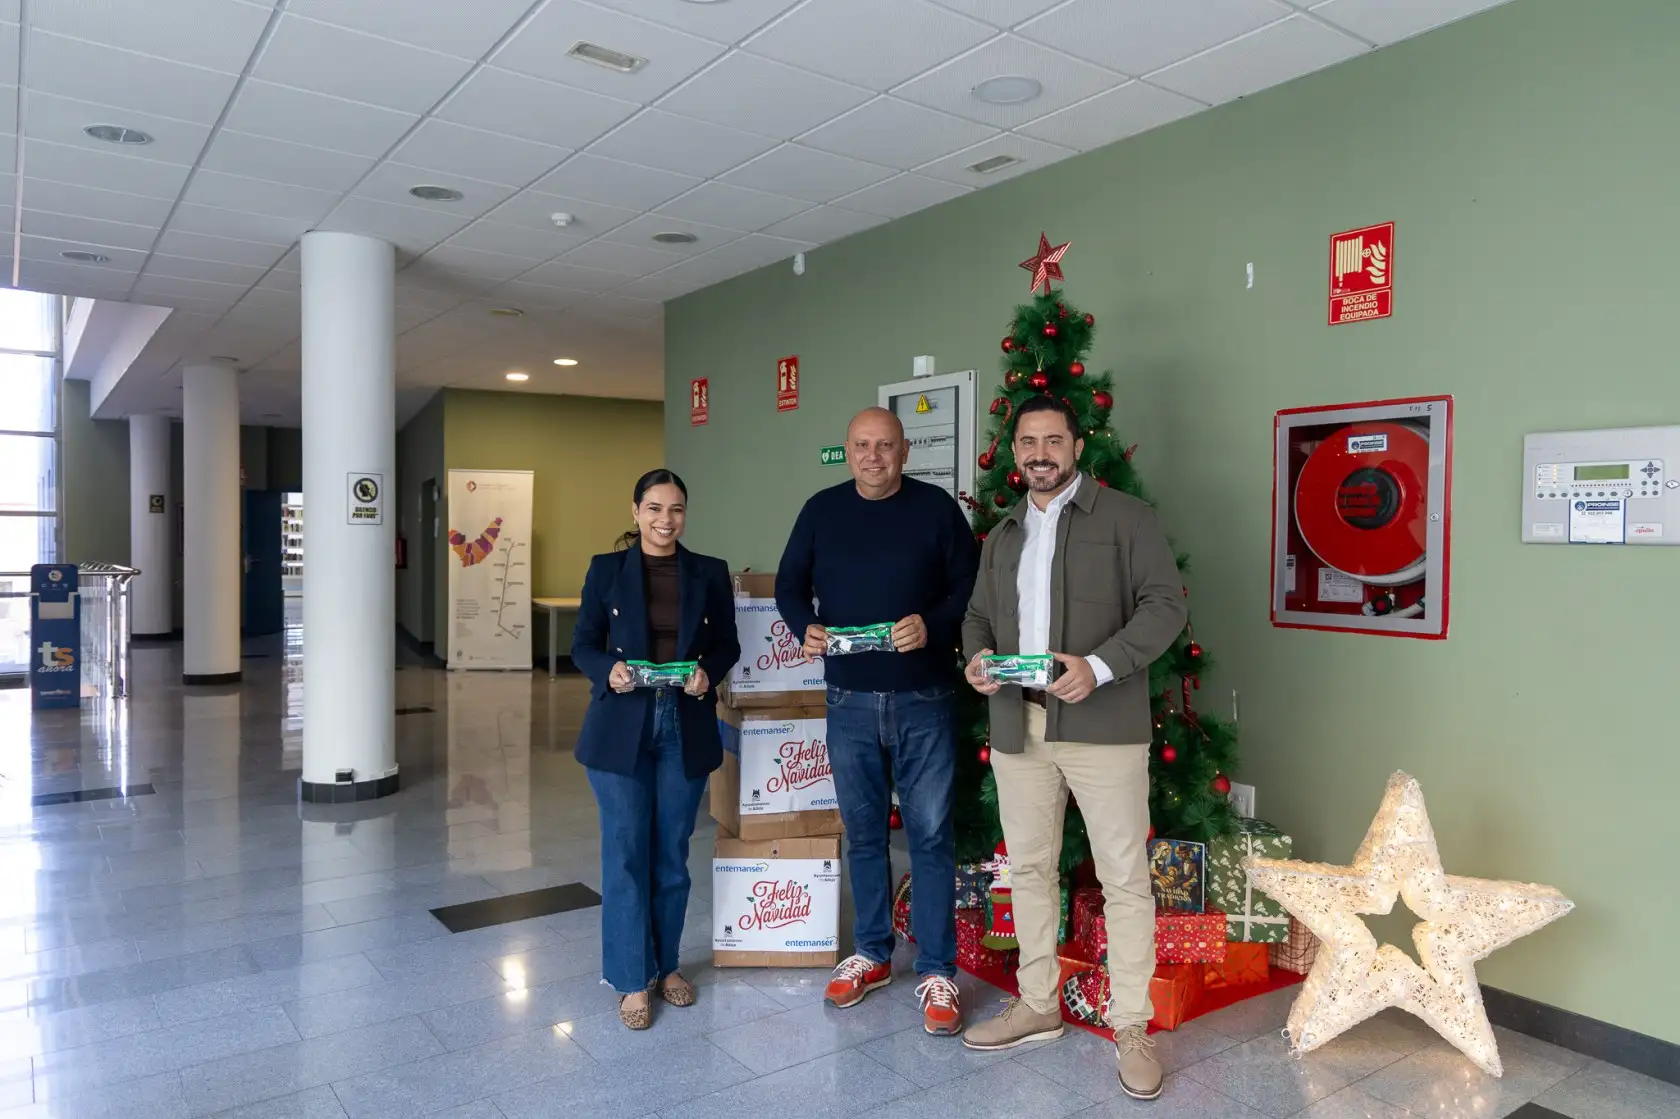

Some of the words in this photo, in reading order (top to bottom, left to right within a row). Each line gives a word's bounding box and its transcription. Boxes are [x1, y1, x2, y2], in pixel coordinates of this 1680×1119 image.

[1343, 296, 1364, 305] BOCA
[1366, 293, 1377, 301] DE
[1341, 301, 1378, 312] INCENDIO
[1340, 309, 1379, 321] EQUIPADA
[831, 450, 843, 460] DEA
[743, 726, 790, 736] entemanser
[780, 739, 828, 769] Feliz
[715, 864, 764, 873] entemanser
[752, 879, 808, 909] Feliz
[738, 896, 812, 930] Navidad
[785, 939, 833, 947] entemanser
